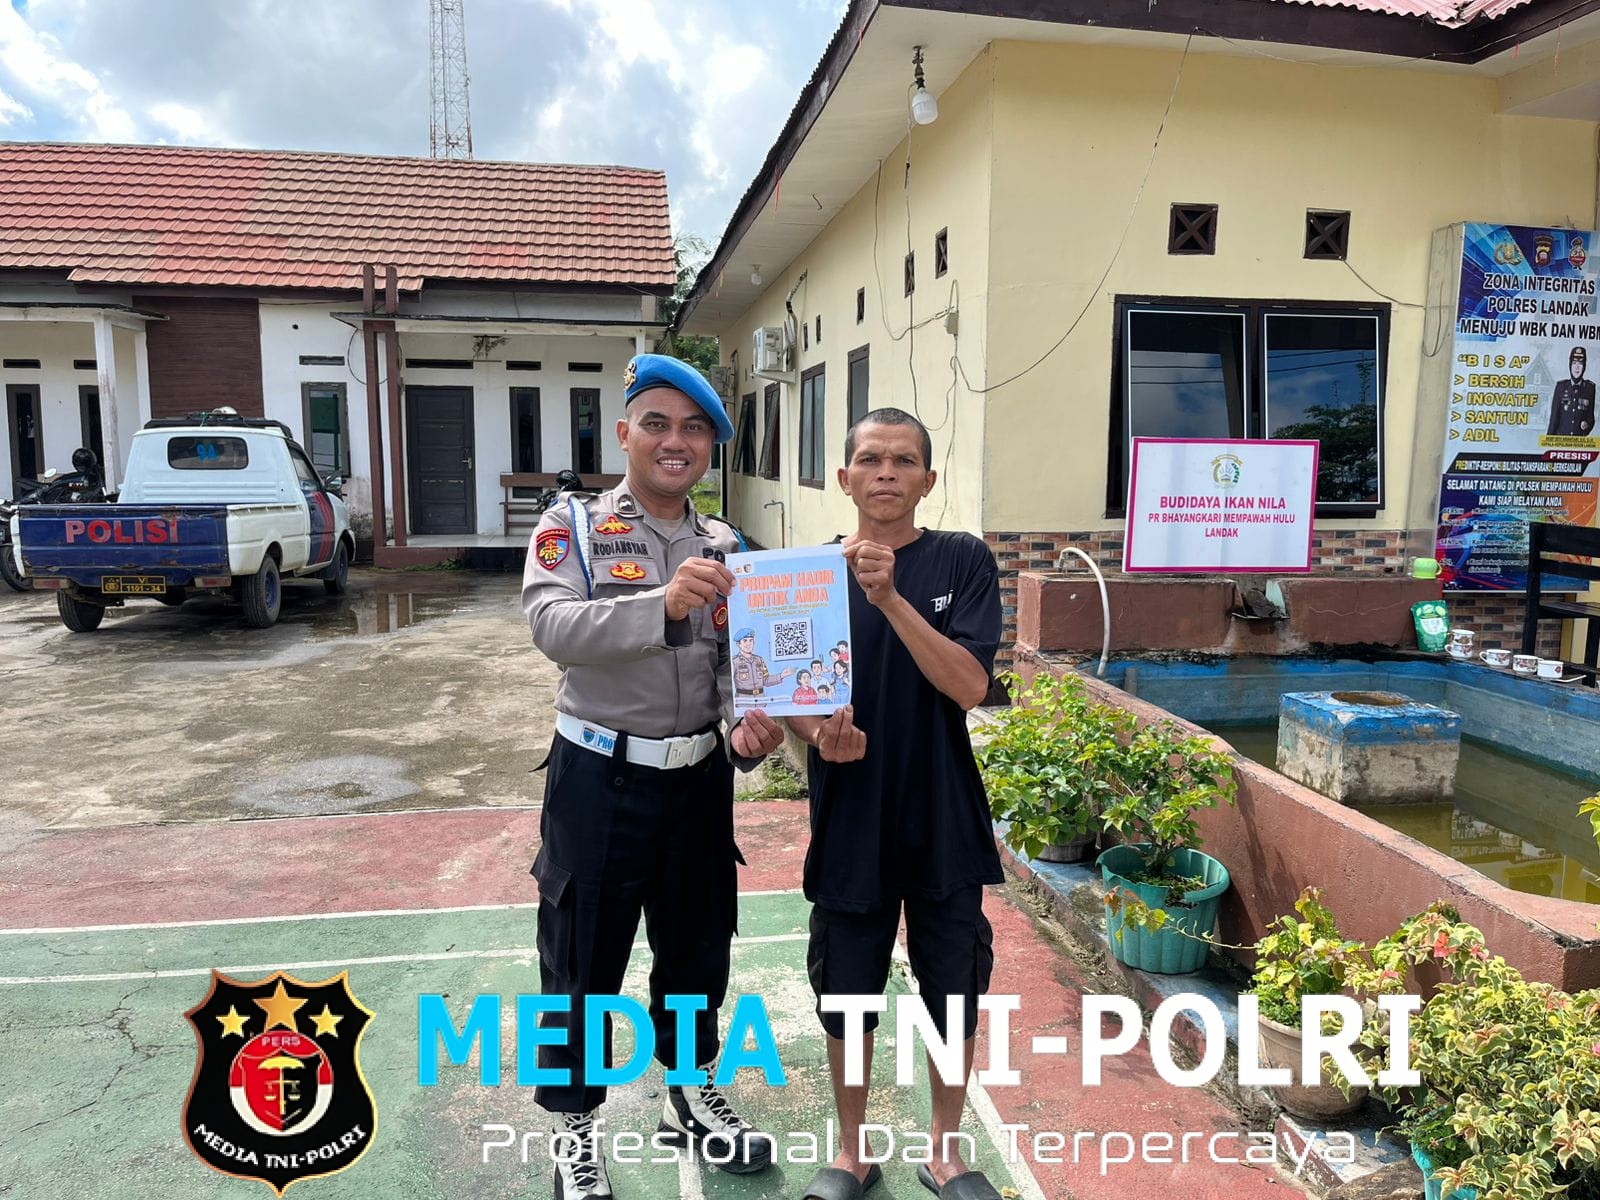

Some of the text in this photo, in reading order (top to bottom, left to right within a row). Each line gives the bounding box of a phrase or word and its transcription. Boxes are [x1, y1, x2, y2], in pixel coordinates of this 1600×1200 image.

[1483, 273, 1595, 295] ZONA INTEGRITAS
[1488, 297, 1589, 317] POLRES LANDAK
[1460, 319, 1516, 335] MENUJU
[1519, 321, 1548, 337] WBK
[1551, 323, 1575, 339] DAN
[1468, 374, 1525, 389] BERSIH
[1466, 392, 1538, 407] INOVATIF
[1465, 410, 1529, 425] SANTUN
[1462, 428, 1500, 442] ADIL
[1550, 451, 1591, 460] PRESISI
[1446, 479, 1593, 493] SELAMAT DATANG DI POLSEK MEMPAWAH HULU
[1160, 495, 1286, 509] BUDIDAYA IKAN NILA
[1478, 496, 1562, 507] KAMI SIAP MELAYANI ANDA
[1148, 513, 1295, 524] PR BHAYANGKARI MEMPAWAH HULU
[64, 519, 180, 544] POLISI
[1205, 528, 1238, 538] LANDAK
[592, 540, 649, 557] RODIANSYAH
[794, 586, 829, 604] ANDA
